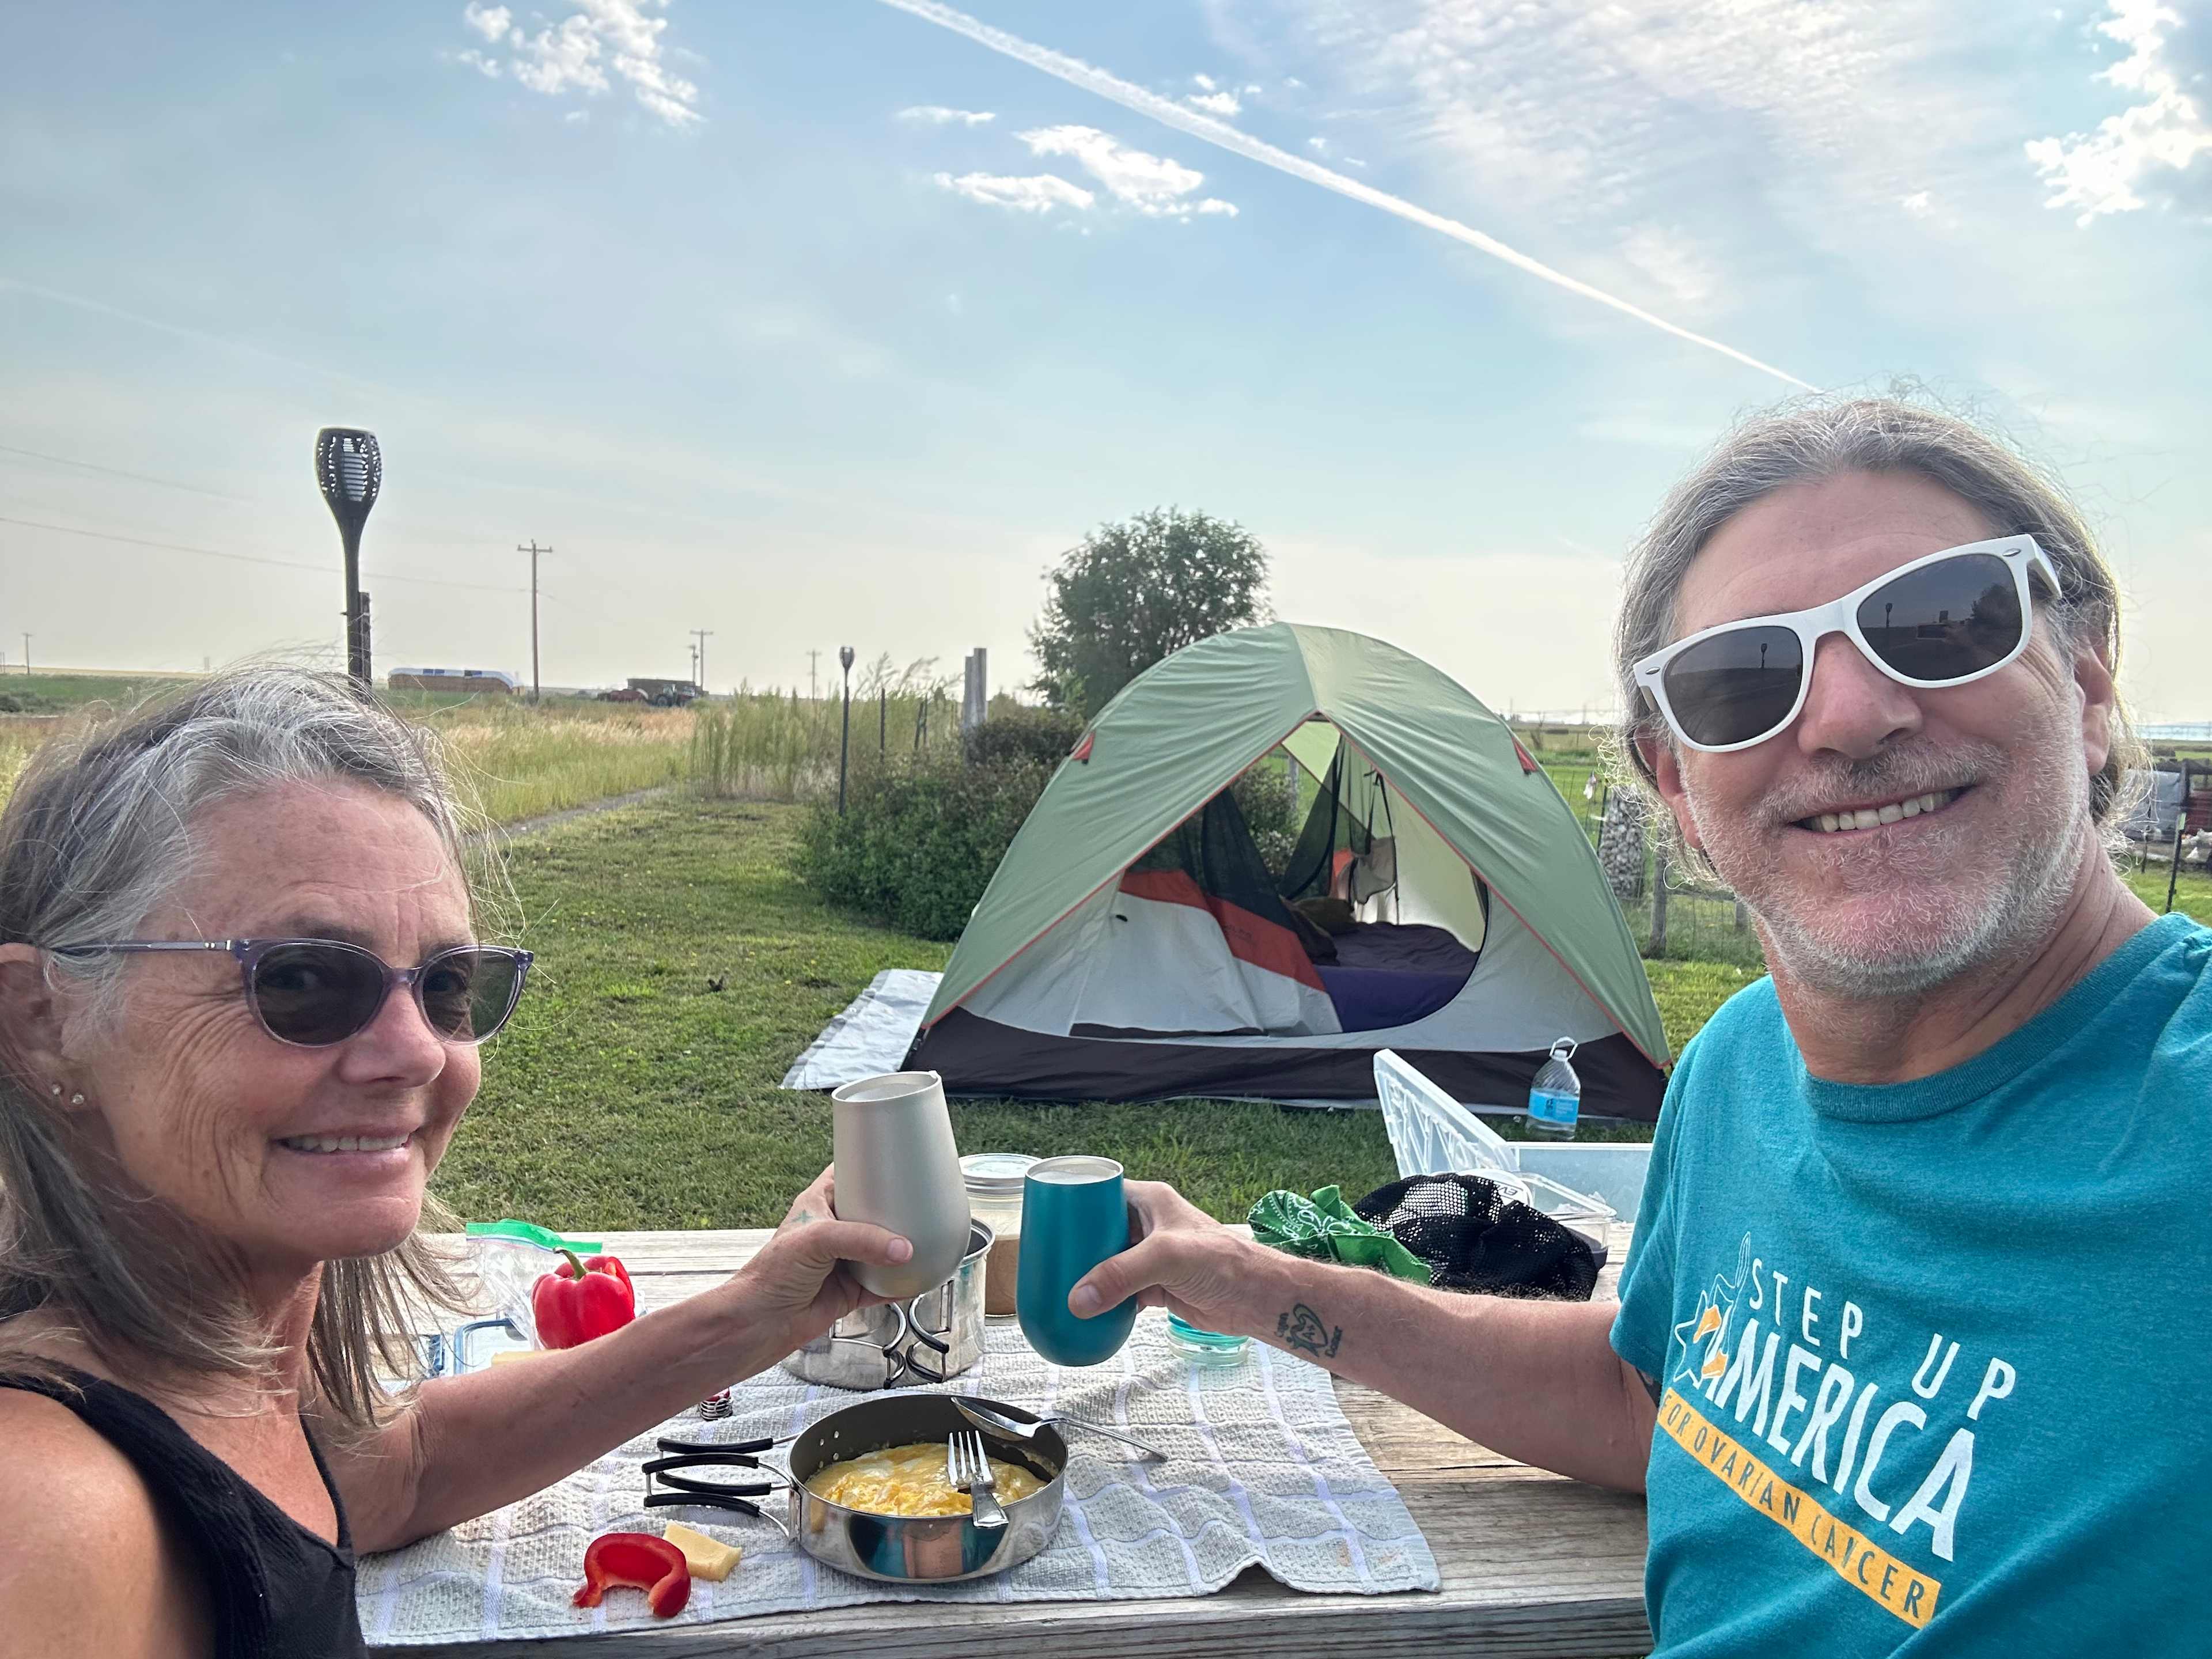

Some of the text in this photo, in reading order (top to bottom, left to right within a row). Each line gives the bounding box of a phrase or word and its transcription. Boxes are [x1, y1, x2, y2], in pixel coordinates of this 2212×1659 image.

[1749, 1258, 2016, 1421] STEP UP
[1658, 1394, 1692, 1437] FOR
[1694, 1426, 1801, 1525] OVARIAN
